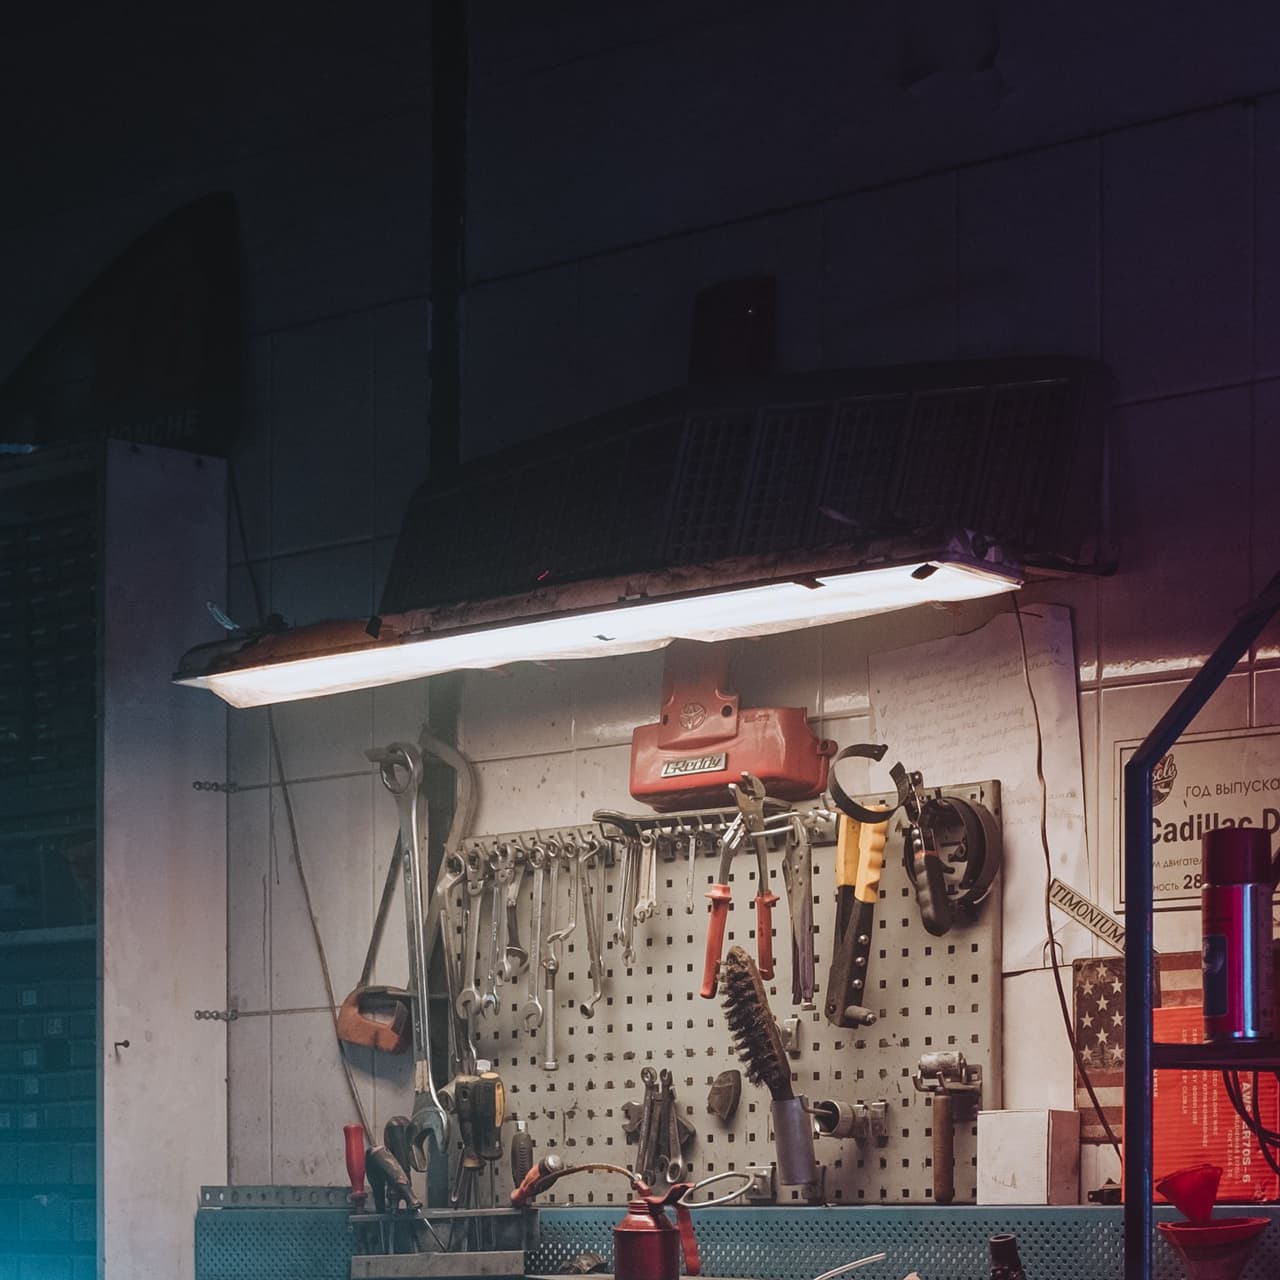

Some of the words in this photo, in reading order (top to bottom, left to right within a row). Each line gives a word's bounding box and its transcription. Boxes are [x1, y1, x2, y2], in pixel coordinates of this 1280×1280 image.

[1186, 782, 1211, 799] год
[1216, 778, 1280, 797] выпуска
[1052, 884, 1125, 943] TIMONIUM
